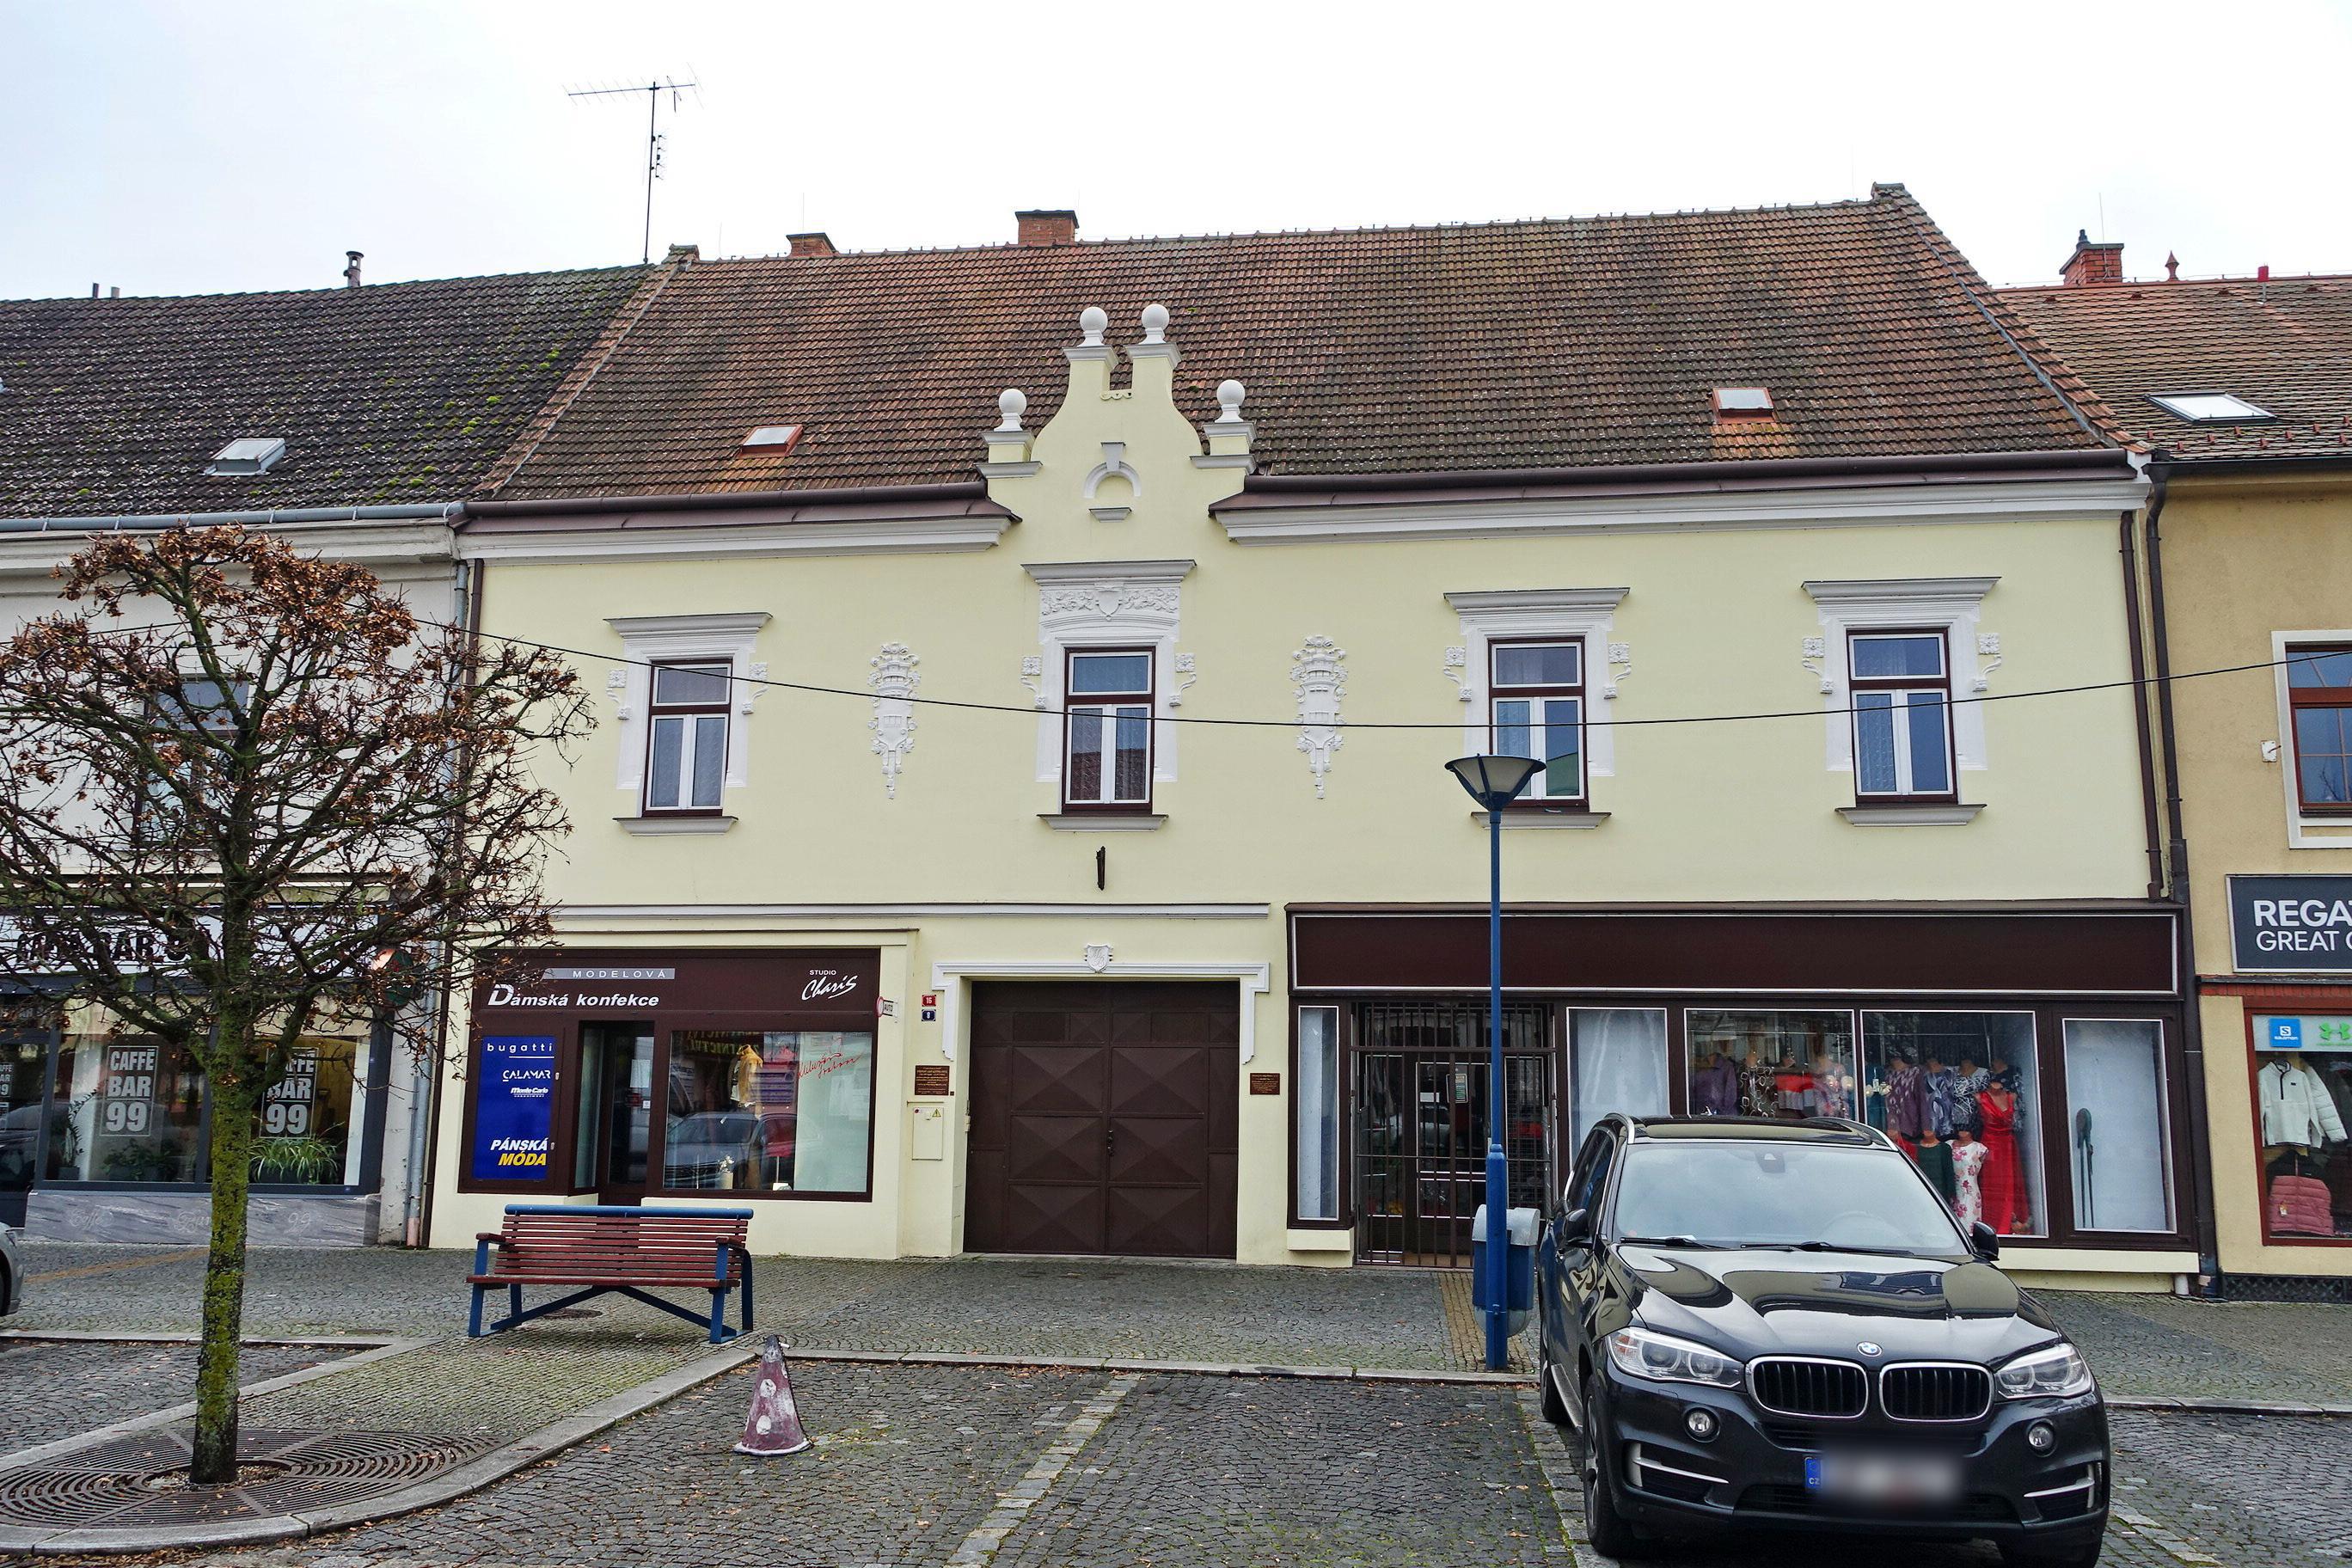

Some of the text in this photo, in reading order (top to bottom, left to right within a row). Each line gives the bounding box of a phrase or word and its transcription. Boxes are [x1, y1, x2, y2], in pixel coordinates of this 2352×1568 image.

[2256, 930, 2339, 951] GREAT
[573, 969, 665, 978] MODELOVÁ
[575, 994, 659, 1006] konfekce
[487, 1043, 553, 1053] bugatti
[502, 1069, 551, 1080] CALAMAR
[107, 1075, 151, 1097] BAR
[106, 1101, 147, 1132] 99
[266, 1104, 308, 1134] 99
[490, 1137, 549, 1150] PÁNSKÁ
[498, 1150, 547, 1166] MÓDA
